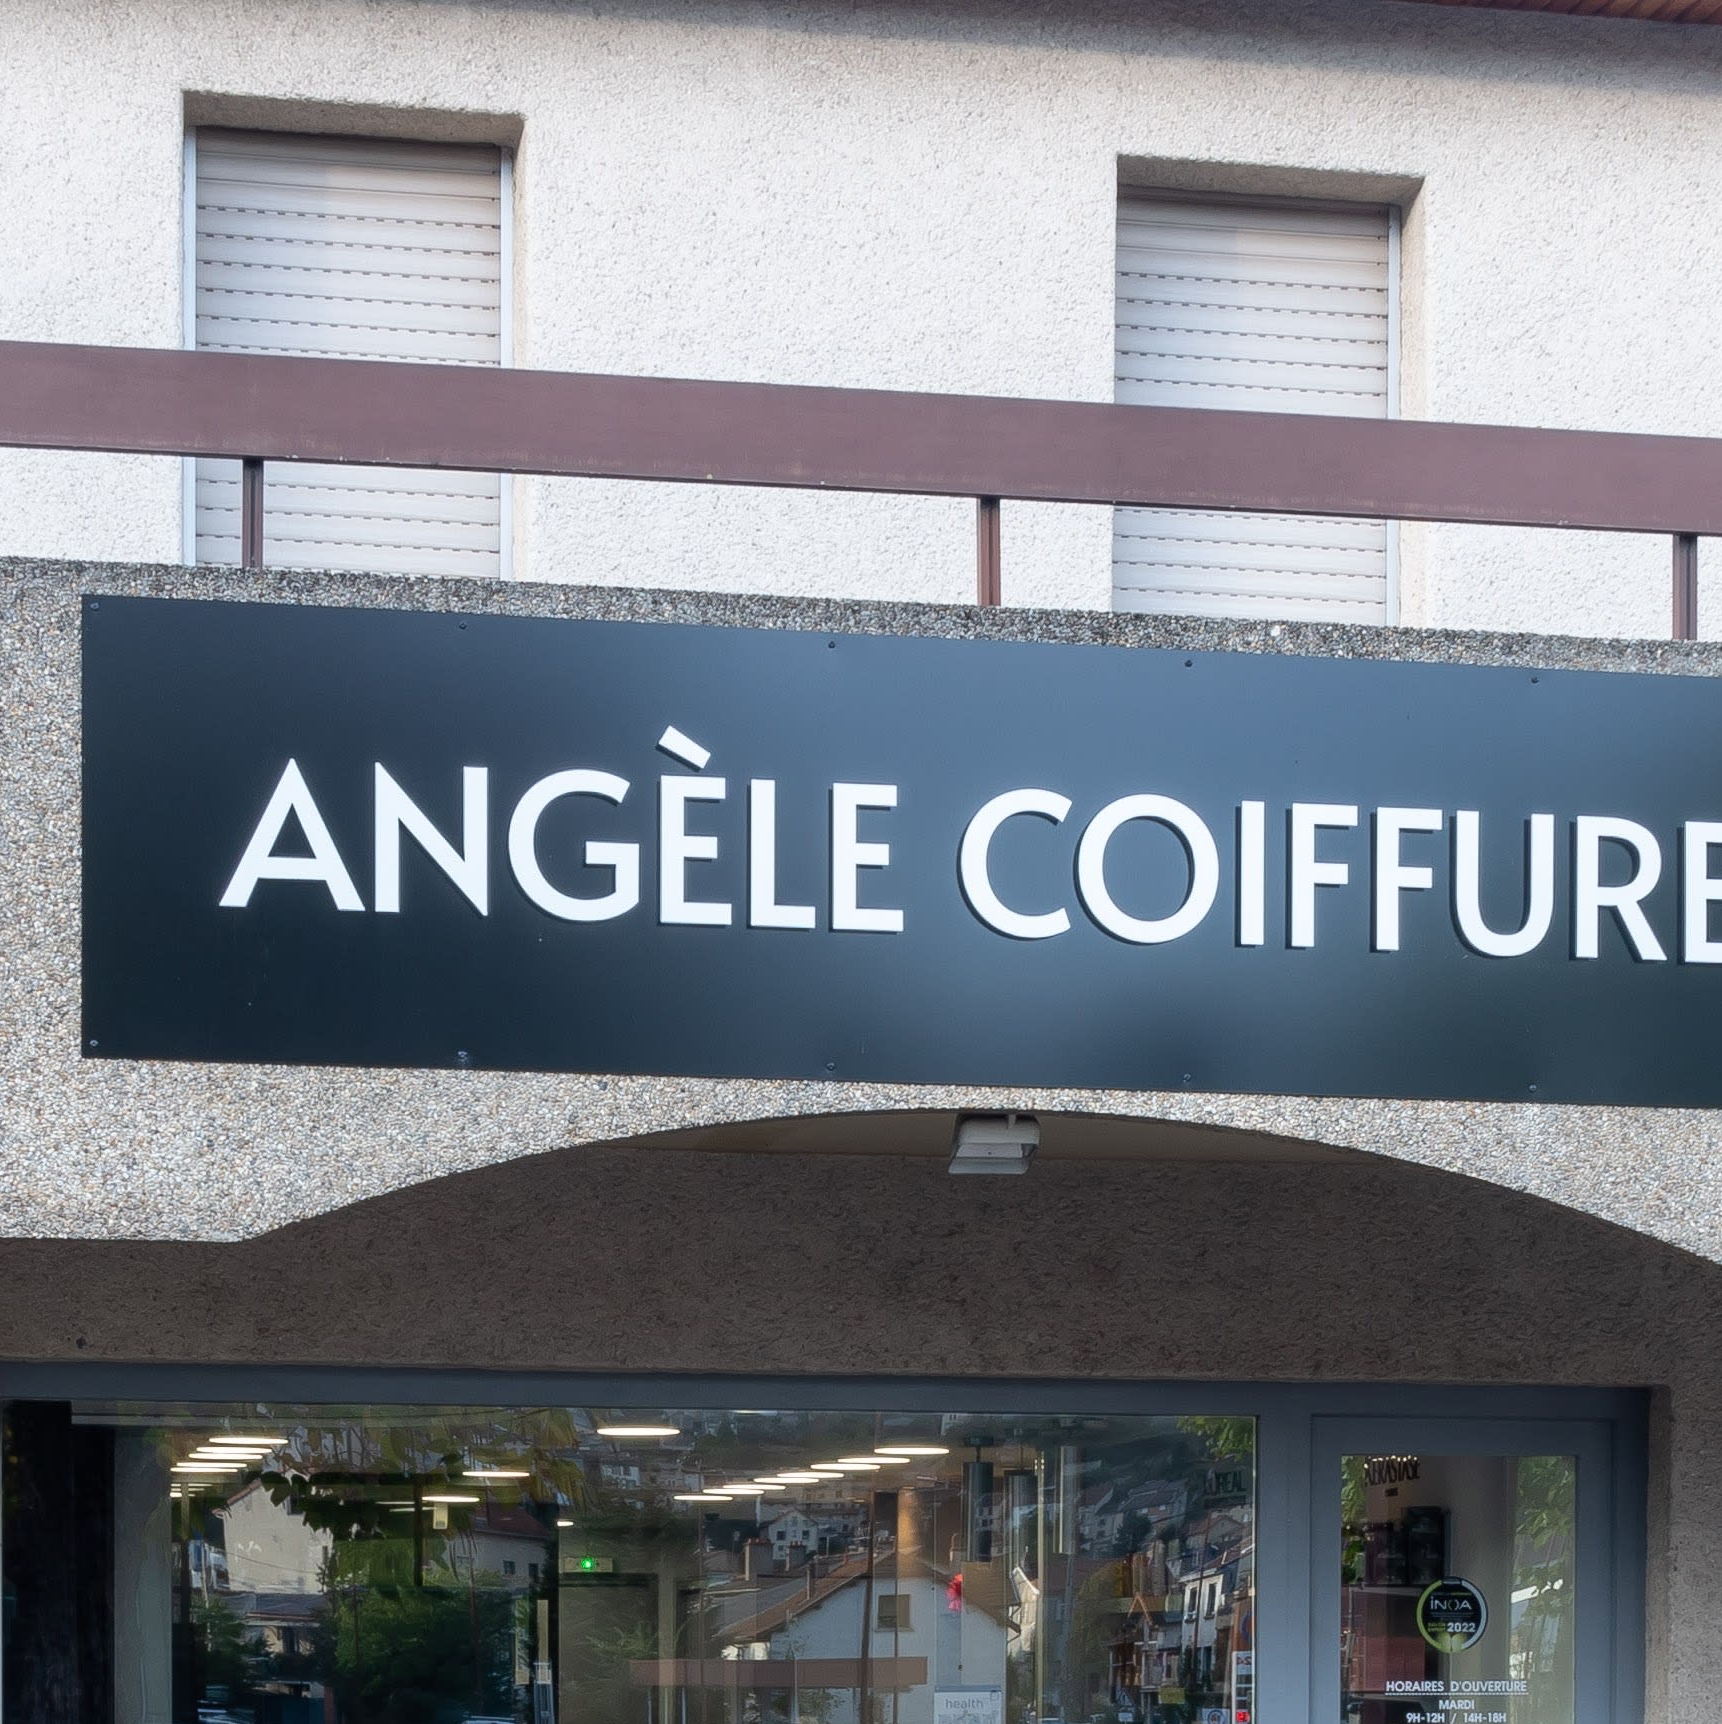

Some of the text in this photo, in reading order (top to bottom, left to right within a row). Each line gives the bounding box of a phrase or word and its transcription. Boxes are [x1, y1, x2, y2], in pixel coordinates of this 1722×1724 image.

[218, 725, 904, 934] ANGÈLE
[1447, 1623, 1476, 1632] 2022
[1386, 1680, 1527, 1692] HORAIRES D'OUVERTURE
[1439, 1700, 1475, 1710] MARDI
[1406, 1713, 1507, 1723] 9H-12H 14H-18H
